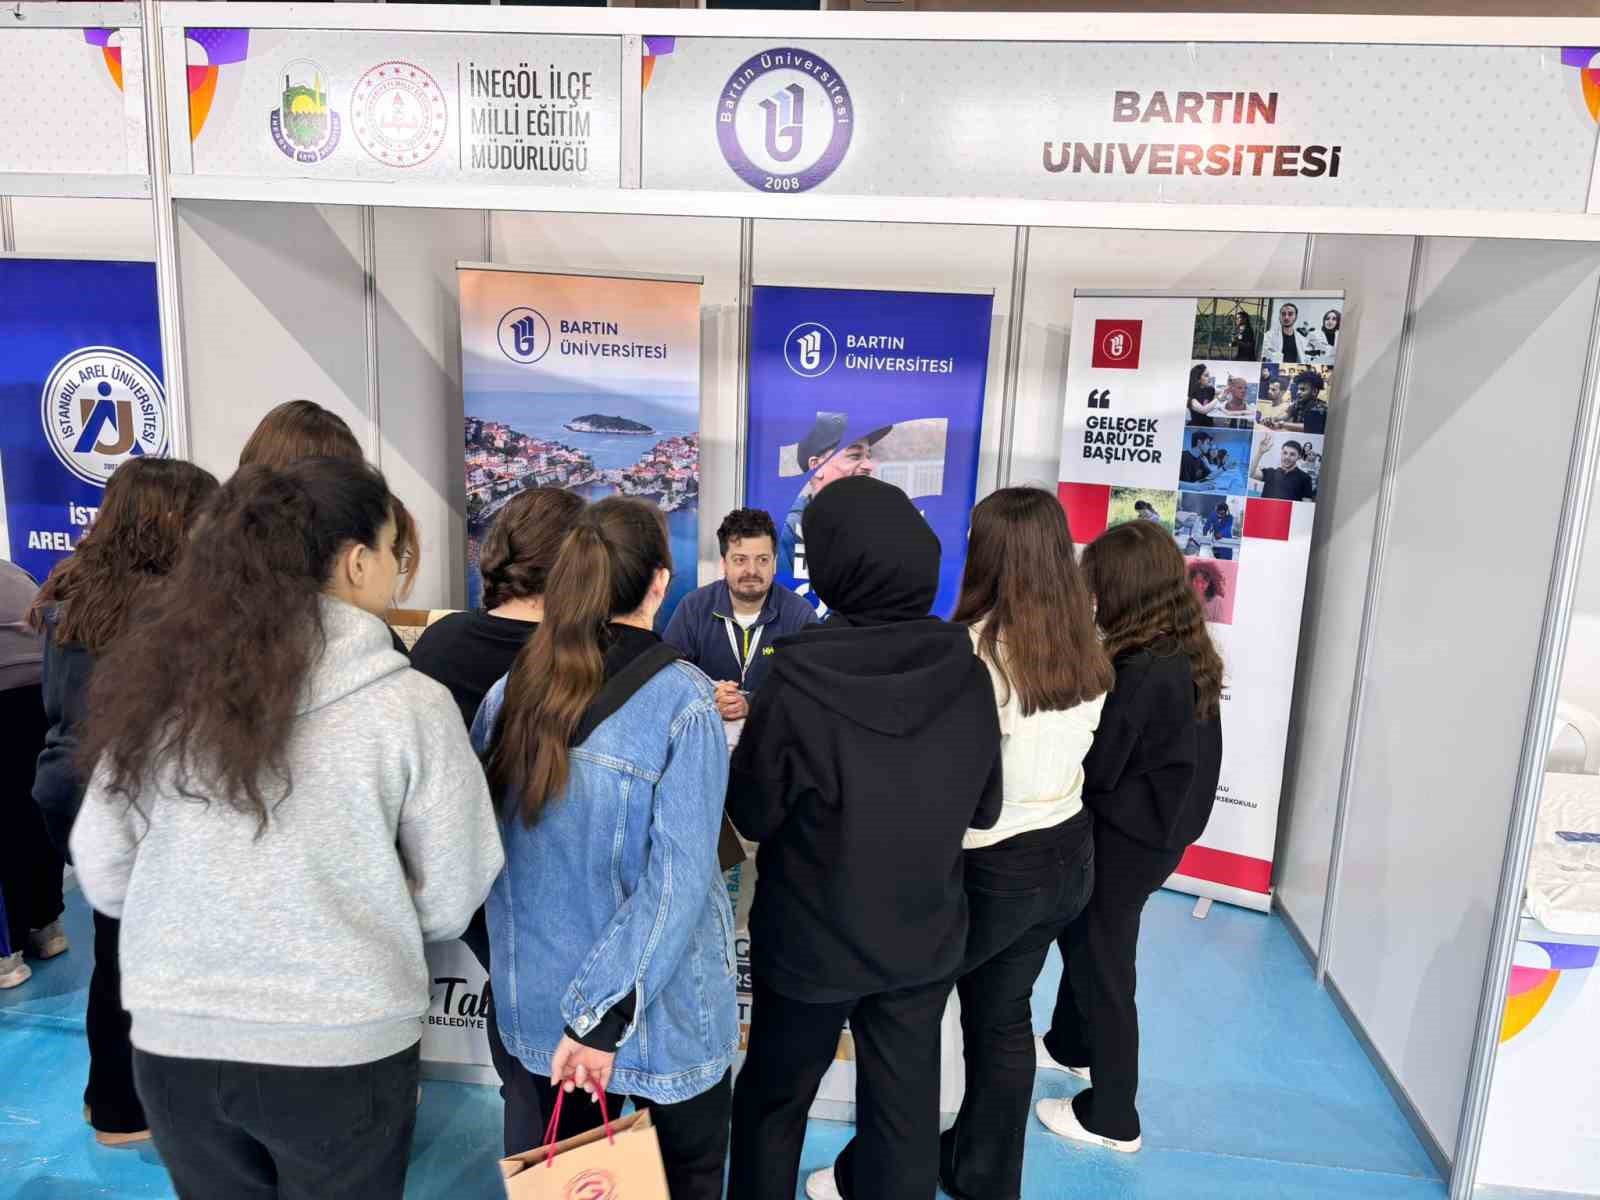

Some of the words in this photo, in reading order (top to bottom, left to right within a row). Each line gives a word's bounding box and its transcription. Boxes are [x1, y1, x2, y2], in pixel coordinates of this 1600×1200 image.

[469, 62, 543, 99] İNEGÖL
[550, 64, 593, 108] İLÇE
[760, 52, 849, 124] Üniversitesi
[1112, 90, 1279, 125] BARTIN
[471, 102, 520, 136] MİLLİ
[527, 103, 591, 137] EĞİTİM
[471, 138, 588, 172] MÜDÜRLÜĞÜ
[1041, 141, 1342, 178] ÜNİVERSİTESİ
[764, 177, 801, 191] 2008
[560, 320, 619, 336] BARTIN
[560, 339, 668, 359] ÜNİVERSİTESİ
[846, 334, 905, 350] BARTIN
[845, 353, 954, 374] ÜNİVERSİTESİ
[58, 379, 81, 441] İSTANBUL
[78, 364, 109, 384] AREL
[111, 363, 160, 446] ÜNİVERSİTESİ
[1085, 415, 1159, 433] GELECEK
[1082, 445, 1162, 464] BAŞLIYOR
[28, 530, 77, 552] AREL
